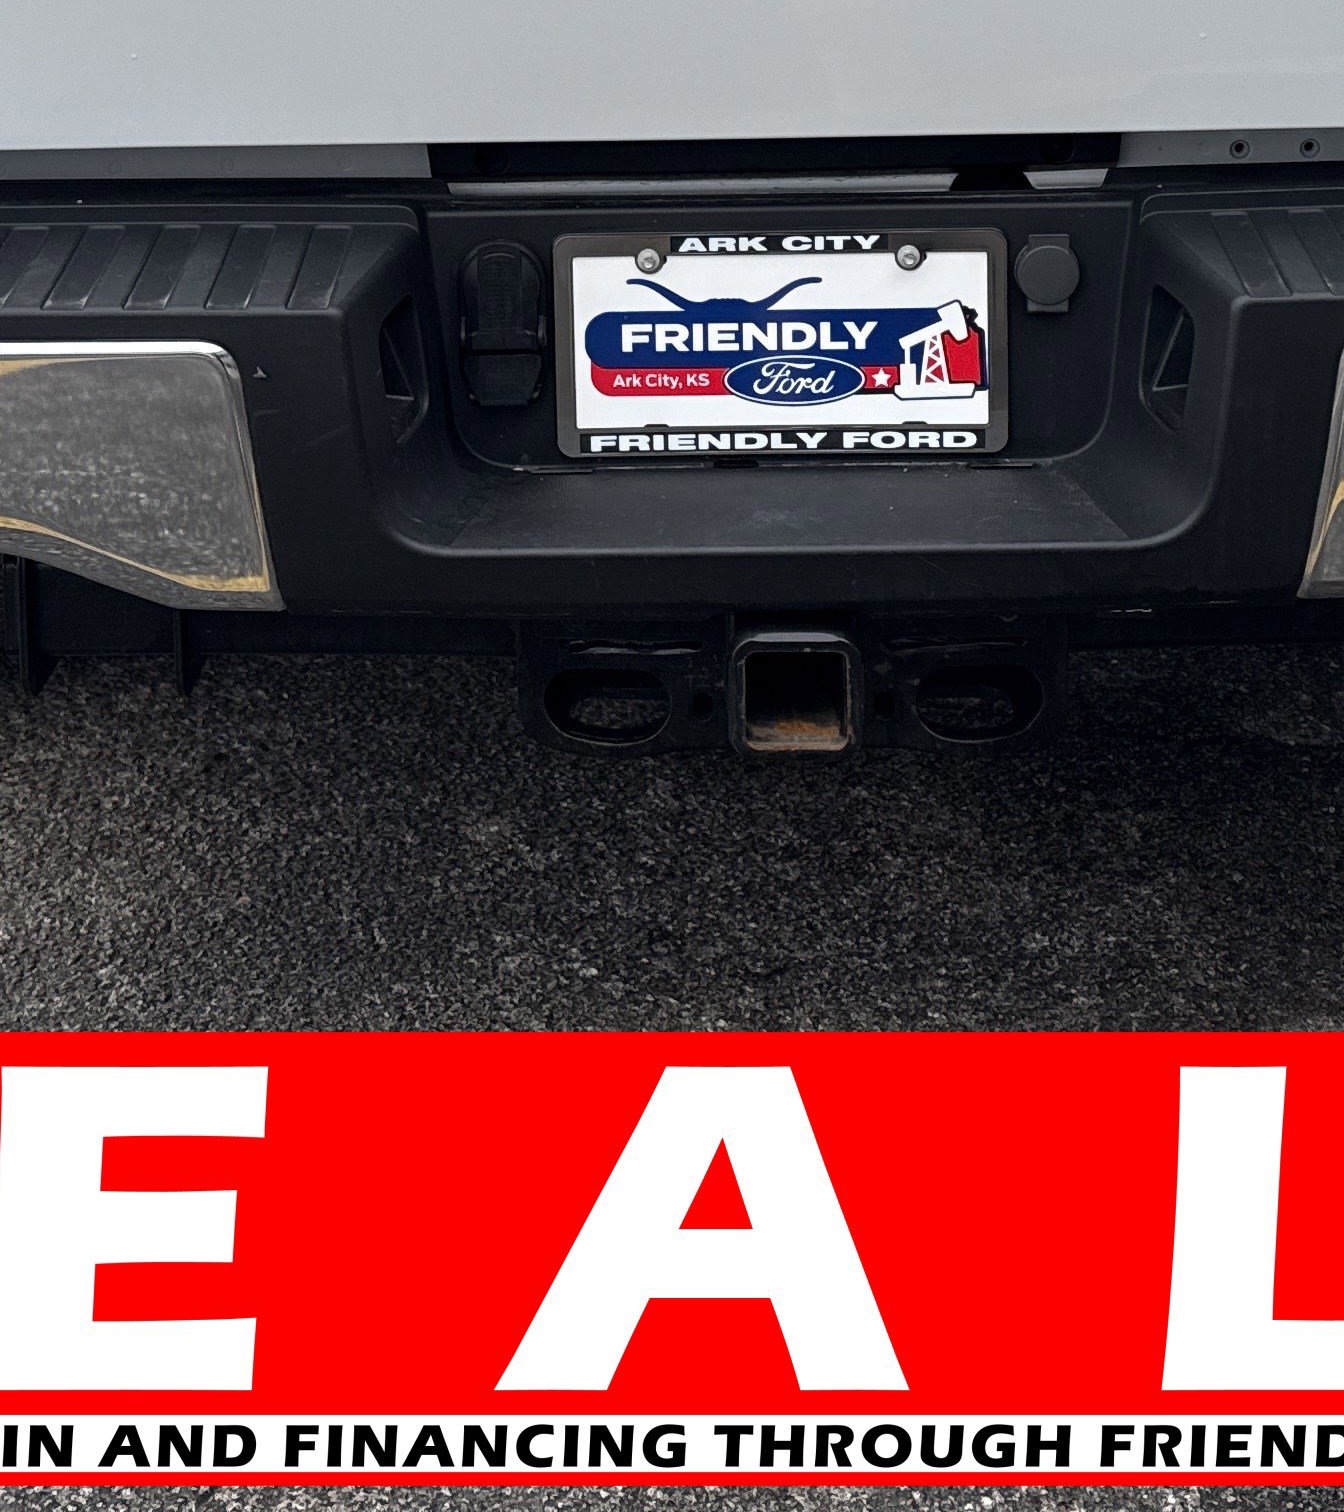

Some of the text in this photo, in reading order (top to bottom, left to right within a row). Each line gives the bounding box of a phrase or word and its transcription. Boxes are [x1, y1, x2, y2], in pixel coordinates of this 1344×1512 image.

[678, 234, 881, 253] ARK CITY
[621, 321, 878, 353] FRIENDLY
[612, 372, 710, 392] Ark City, KS
[752, 361, 836, 395] Ford
[590, 431, 978, 452] FRIENDLY FORD
